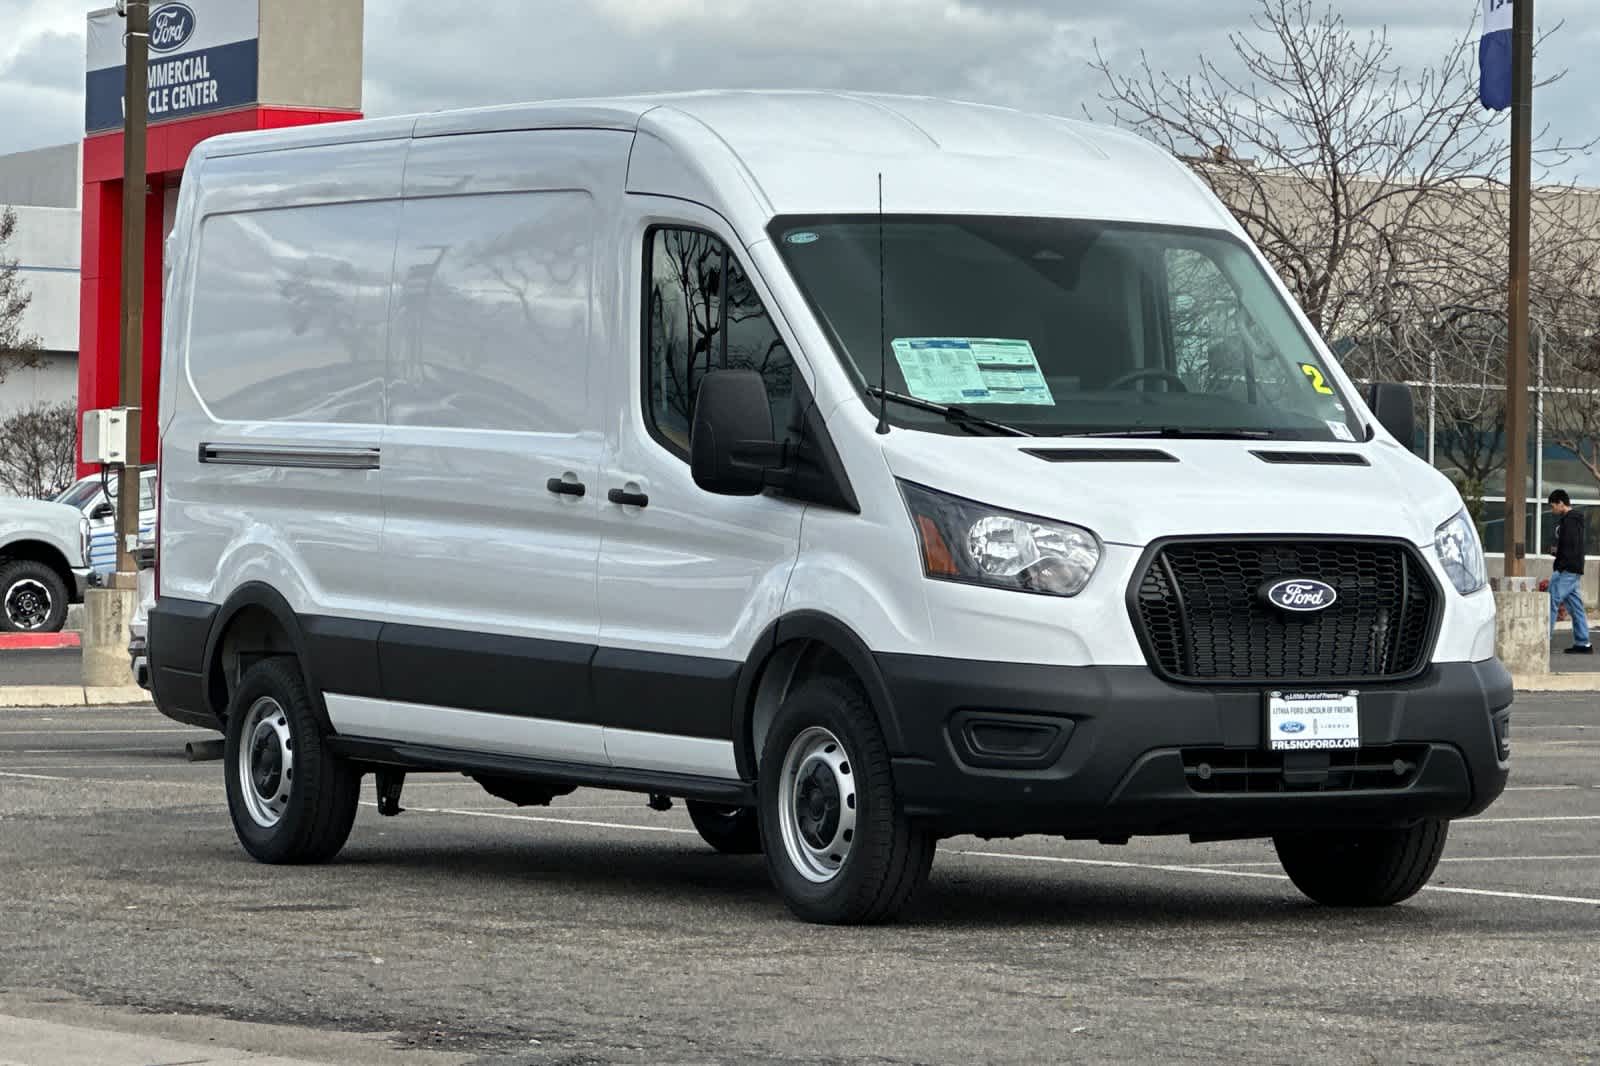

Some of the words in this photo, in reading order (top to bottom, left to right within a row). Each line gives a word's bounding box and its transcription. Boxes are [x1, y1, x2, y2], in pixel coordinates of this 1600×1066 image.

[153, 11, 185, 45] Ford
[147, 56, 209, 89] MMERCIAL
[171, 80, 218, 110] CENTER
[1301, 364, 1334, 395] 2
[1282, 583, 1324, 605] Ford
